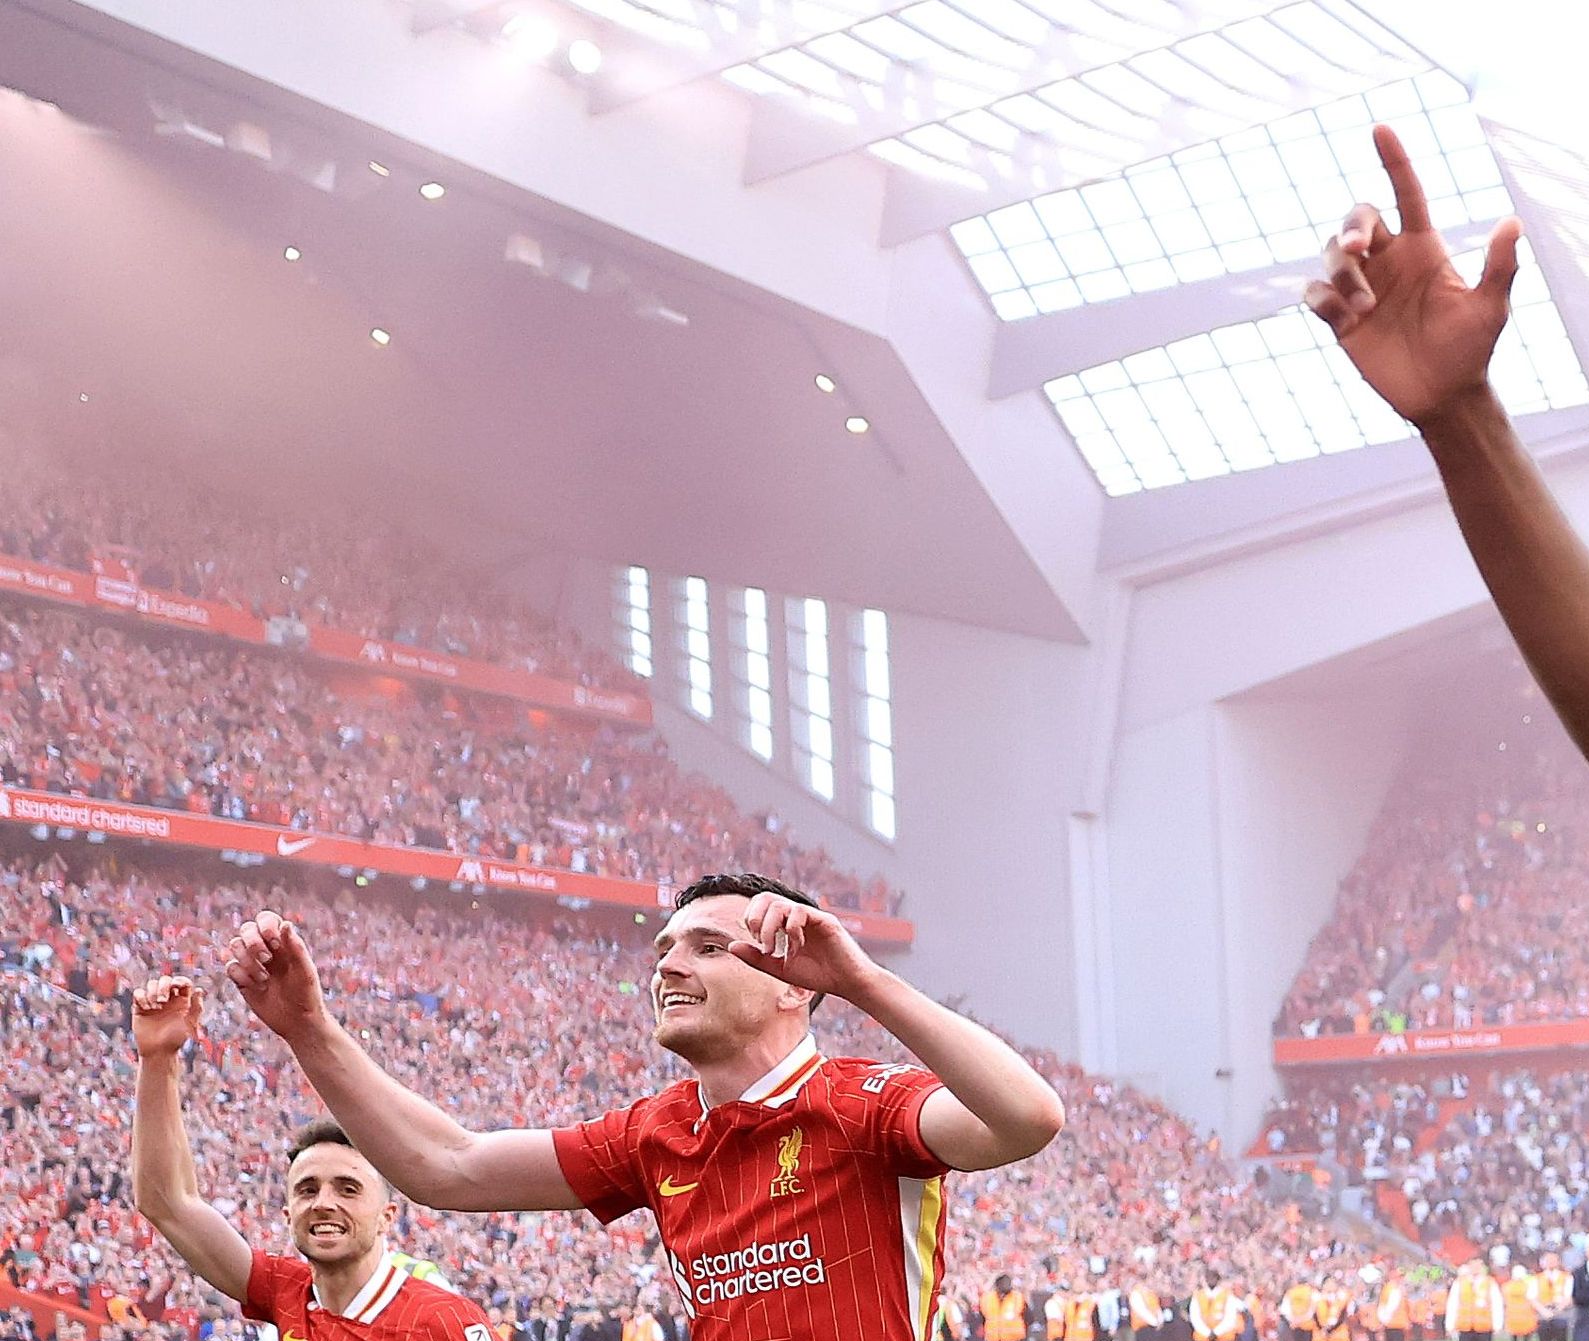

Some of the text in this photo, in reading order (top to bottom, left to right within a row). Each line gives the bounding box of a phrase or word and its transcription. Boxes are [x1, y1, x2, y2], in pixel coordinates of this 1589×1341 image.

[14, 798, 170, 837] standard chartered
[692, 1233, 811, 1280] standard
[696, 1257, 825, 1304] chartered
